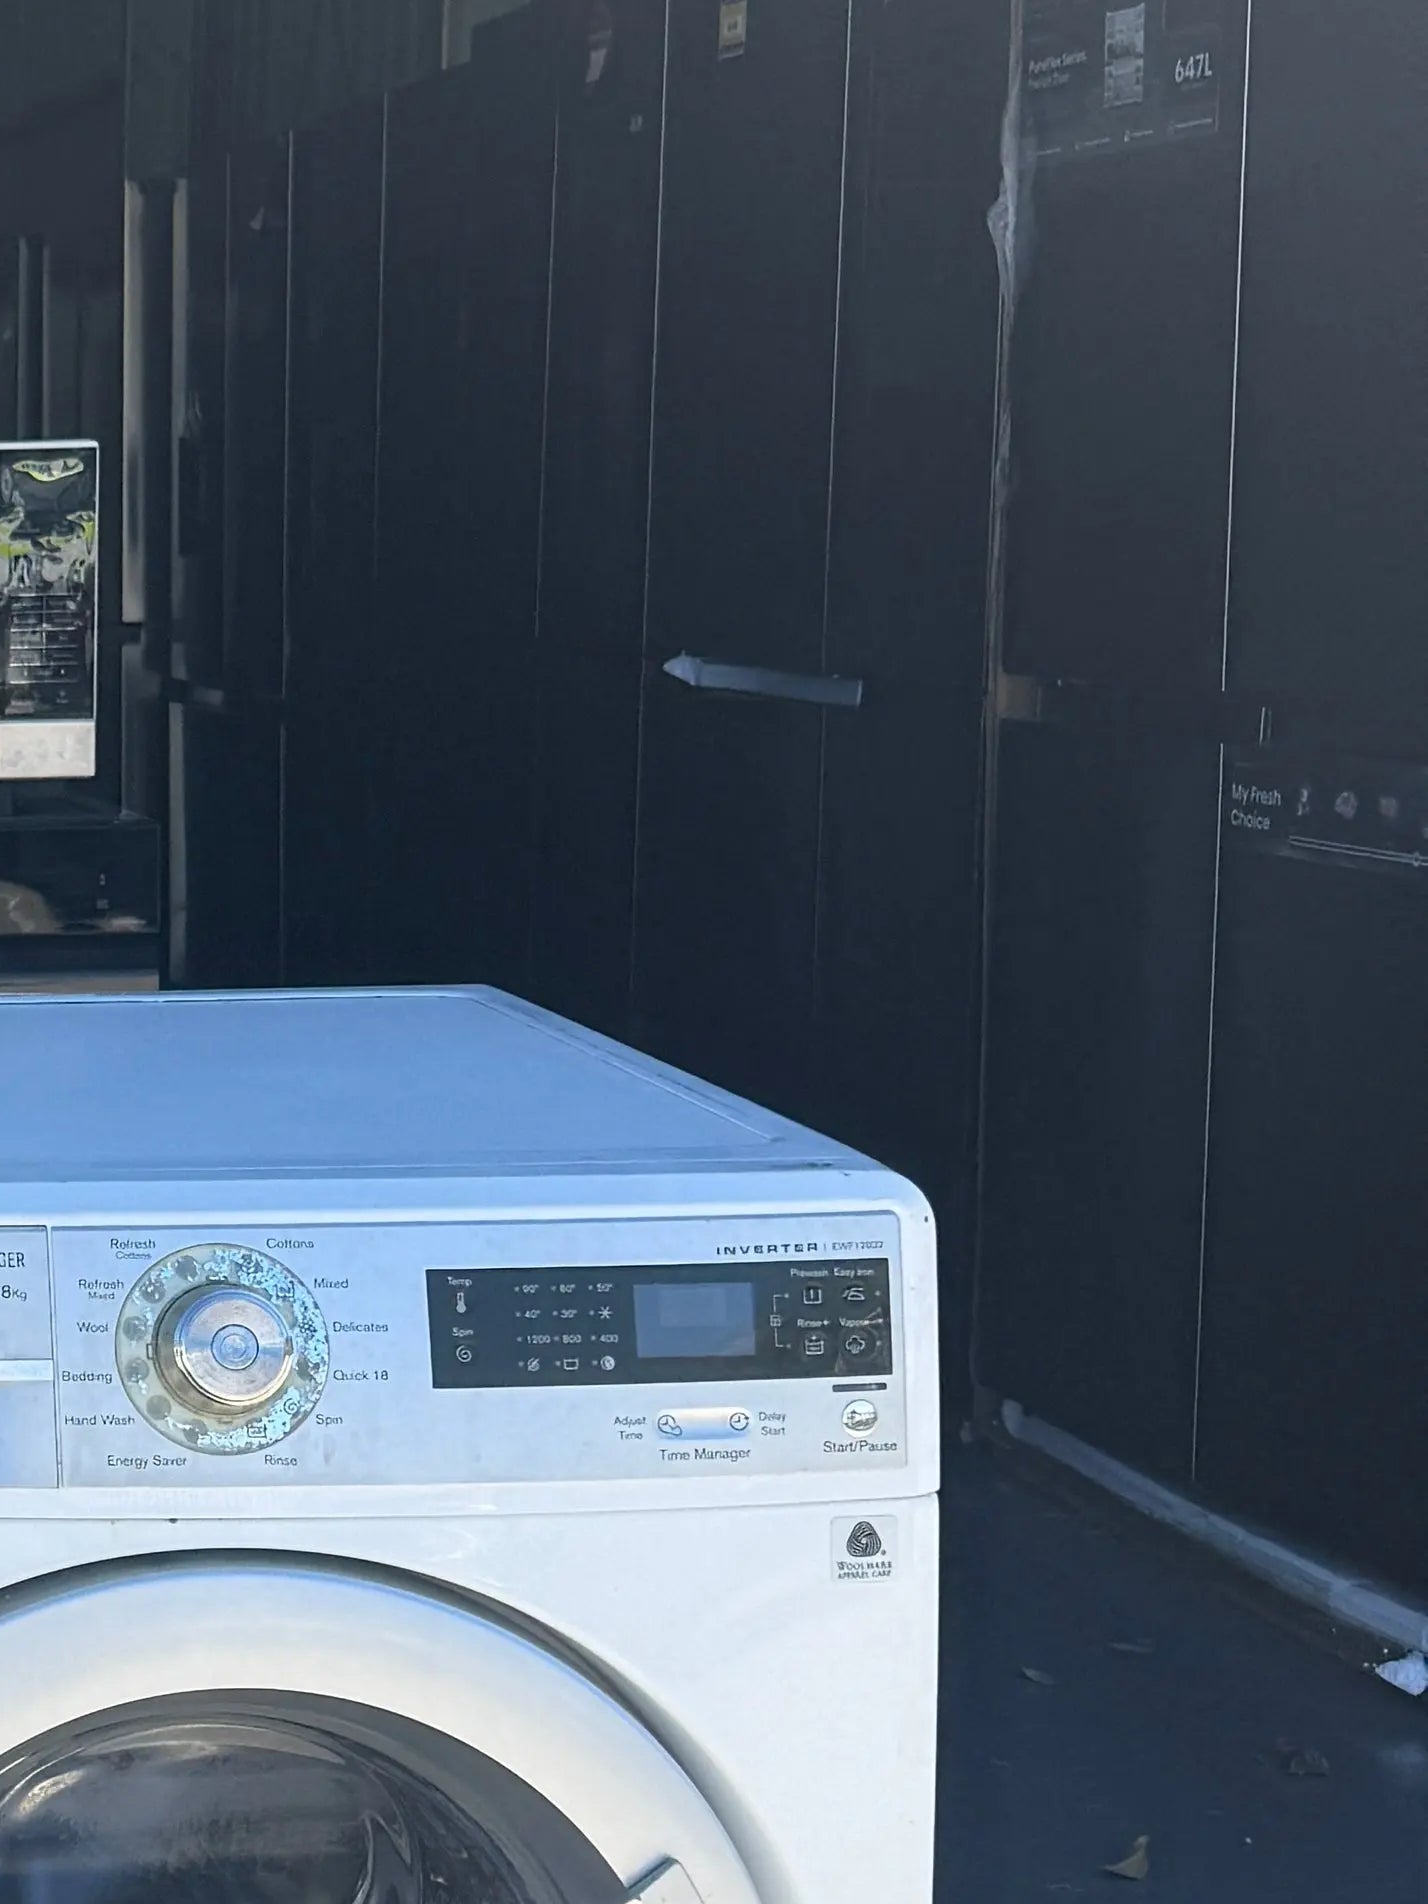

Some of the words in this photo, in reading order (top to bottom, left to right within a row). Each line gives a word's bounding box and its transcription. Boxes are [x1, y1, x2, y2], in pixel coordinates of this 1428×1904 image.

[1175, 52, 1212, 83] 647L
[1231, 809, 1271, 831] Choice
[110, 1238, 156, 1250] Refresh
[266, 1238, 315, 1249] Cottons
[716, 1242, 819, 1255] INVERTER
[78, 1279, 125, 1290] Refresh
[313, 1278, 349, 1289] Mixed
[447, 1276, 473, 1288] Temp
[76, 1322, 109, 1333] Wool
[333, 1322, 389, 1333] Delicates
[527, 1335, 552, 1345] 1200
[599, 1334, 619, 1343] 400
[62, 1371, 113, 1385] Bedding
[333, 1370, 369, 1381] Quick
[374, 1370, 389, 1381] 18
[64, 1414, 97, 1426] Hand
[101, 1414, 136, 1426] Wash
[316, 1414, 344, 1427] Spin
[759, 1412, 787, 1424] Delay
[619, 1431, 643, 1441] Time
[761, 1426, 785, 1436] Start
[823, 1439, 898, 1453] Start/Pause
[107, 1455, 149, 1469] Energy
[152, 1454, 188, 1466] Saver
[264, 1455, 298, 1466] Rinse
[659, 1449, 690, 1462] Time
[694, 1448, 752, 1463] Manager
